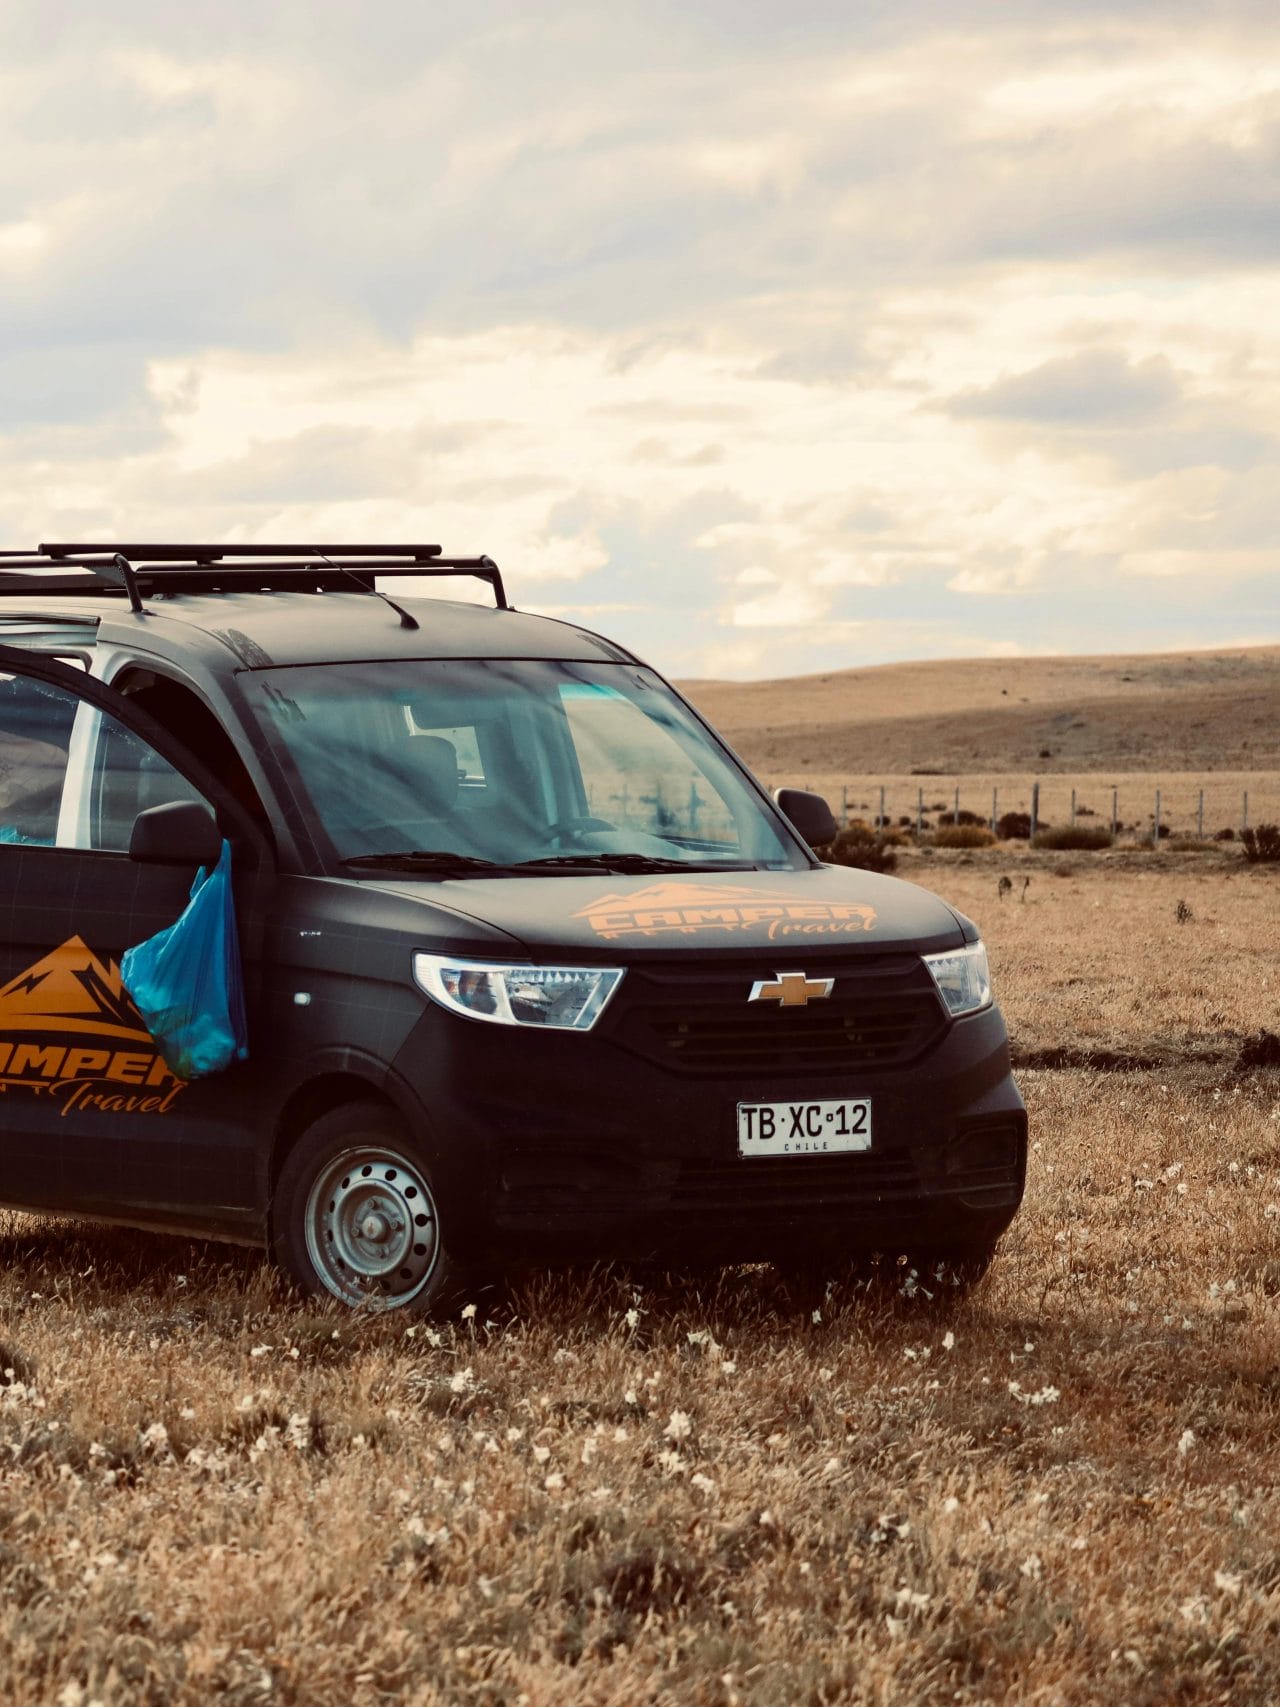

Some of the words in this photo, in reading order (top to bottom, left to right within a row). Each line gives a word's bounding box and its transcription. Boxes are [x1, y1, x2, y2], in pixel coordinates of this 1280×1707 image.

[588, 905, 876, 930] CAMPER
[742, 916, 878, 940] Travel
[49, 1077, 188, 1117] Travel
[784, 1141, 828, 1151] CHILE
